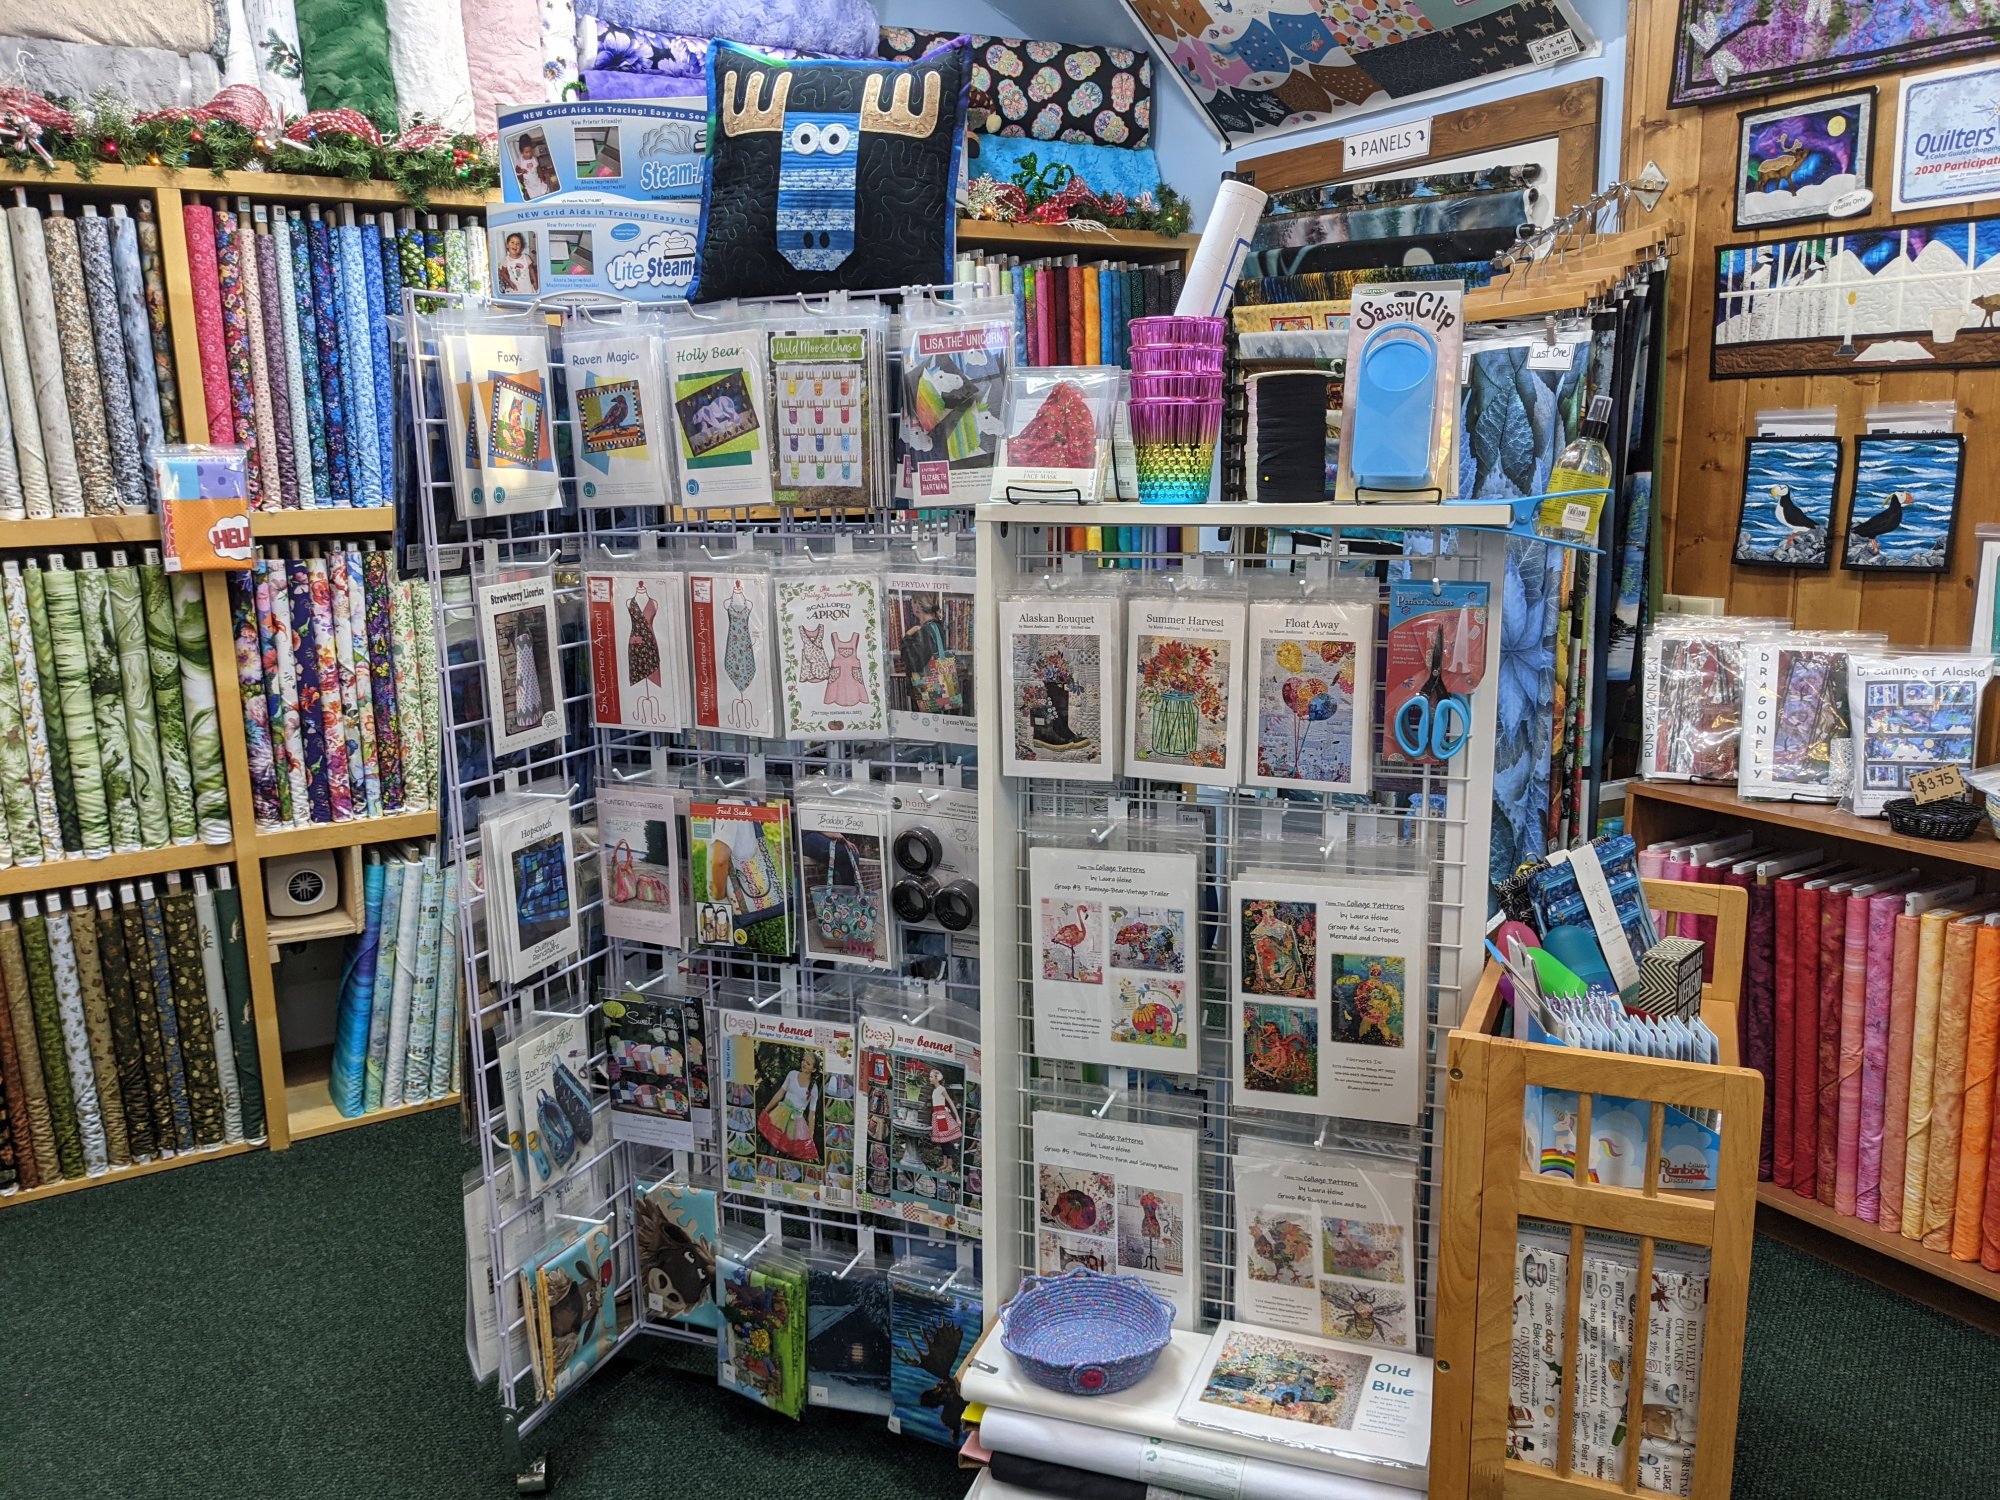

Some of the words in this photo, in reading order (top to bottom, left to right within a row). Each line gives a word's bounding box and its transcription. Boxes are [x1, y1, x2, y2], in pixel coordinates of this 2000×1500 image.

[523, 112, 543, 120] NEW
[547, 108, 567, 116] Grid
[571, 106, 591, 114] Aids
[595, 106, 604, 114] in
[607, 106, 647, 116] Tracing!
[651, 108, 673, 118] Easy
[676, 110, 686, 118] to
[688, 112, 706, 120] See
[1361, 131, 1412, 158] PANELS
[1915, 127, 1996, 156] Quilters
[1948, 149, 1972, 158] Guided
[1914, 164, 1942, 176] 2020
[1832, 198, 1851, 212] Display
[1852, 196, 1866, 206] Only
[518, 212, 539, 220] NEW
[570, 208, 591, 216] Aids
[608, 210, 650, 220] Tracing!
[654, 214, 676, 222] Easy
[680, 216, 690, 224] to
[615, 261, 644, 282] Lite
[1356, 292, 1456, 332] SassyClip
[776, 339, 798, 355] Wild
[800, 340, 830, 354] Moose
[831, 336, 858, 354] Chase
[924, 336, 944, 350] LISA
[946, 334, 962, 348] THE
[966, 330, 1004, 346] UNICORN
[572, 355, 602, 366] Raven
[606, 352, 636, 364] Magic
[676, 348, 709, 362] Holly
[711, 346, 742, 359] Bear
[1530, 346, 1550, 359] Last
[1553, 345, 1570, 358] One!
[922, 474, 947, 482] ELIZABETH
[922, 484, 948, 492] HARTMAN
[212, 526, 251, 550] HEL
[892, 580, 930, 588] EVERYDAY
[932, 582, 951, 590] TOTE
[490, 592, 523, 605] Strawberry
[523, 586, 544, 599] Licorice
[806, 602, 851, 612] SCALLOPED
[807, 609, 850, 621] APRON
[698, 607, 708, 640] Apron!
[1018, 613, 1054, 622] Alaskan
[1057, 614, 1095, 626] Bouquet
[1146, 614, 1186, 624] Summer
[1188, 616, 1224, 626] Harvest
[1285, 618, 1310, 628] Float
[1312, 620, 1340, 630] Away
[594, 610, 607, 648] Apron!
[699, 642, 708, 684] Centered
[1648, 656, 1659, 684] RUN
[598, 649, 607, 695] Corners
[1922, 666, 1936, 677] of
[1942, 666, 1986, 678] Alaska
[600, 696, 608, 714] Six
[702, 687, 710, 718] Totally
[1645, 689, 1657, 734] SALMON
[1644, 740, 1653, 758] RUN
[1916, 771, 1954, 795] $3.75
[716, 806, 732, 815] Feed
[905, 798, 932, 809] home
[520, 818, 553, 839] Hopscotch
[844, 816, 864, 830] Bags
[1096, 864, 1116, 872] Collage
[1118, 866, 1146, 874] Patterns
[1149, 890, 1170, 898] Trailer
[1346, 900, 1370, 910] Collage
[1372, 902, 1406, 910] Patterns
[1340, 912, 1348, 920] by
[1350, 912, 1370, 920] Laura
[1328, 923, 1348, 931] Group
[1378, 926, 1402, 934] Turtle,
[1329, 932, 1358, 940] Mermaid
[1372, 936, 1400, 944] Octopus
[778, 1022, 814, 1038] bonnet
[916, 1036, 954, 1053] bonnet
[1096, 1132, 1116, 1142] Collage
[1117, 1136, 1144, 1146] Patterns
[1044, 1146, 1061, 1154] Group
[1115, 1156, 1128, 1164] Form
[1139, 1160, 1158, 1170] Sewing
[1660, 1157, 1706, 1178] Rainbow
[1304, 1176, 1326, 1185] Collage
[1328, 1178, 1358, 1188] Patterns
[1277, 1192, 1296, 1200] Group
[1308, 1186, 1326, 1194] Laura
[1327, 1188, 1344, 1196] Heine
[1544, 1302, 1554, 1326] divide
[1618, 1314, 1626, 1333] Beat
[1664, 1316, 1673, 1338] Preheat
[1686, 1320, 1697, 1341] RED
[1532, 1322, 1543, 1346] Bake
[1590, 1325, 1598, 1342] RED
[1542, 1328, 1556, 1360] dough
[1674, 1318, 1684, 1372] CUPCAKES
[1374, 1363, 1412, 1378] Old
[1512, 1338, 1521, 1388] COOKIES
[1520, 1326, 1530, 1404] GINGERBREAD
[1685, 1344, 1696, 1384] VELVET
[1372, 1380, 1414, 1397] Blue
[1590, 1370, 1598, 1403] VANILLA
[1582, 1444, 1590, 1460] Beat
[1662, 1470, 1672, 1490] LARGE
